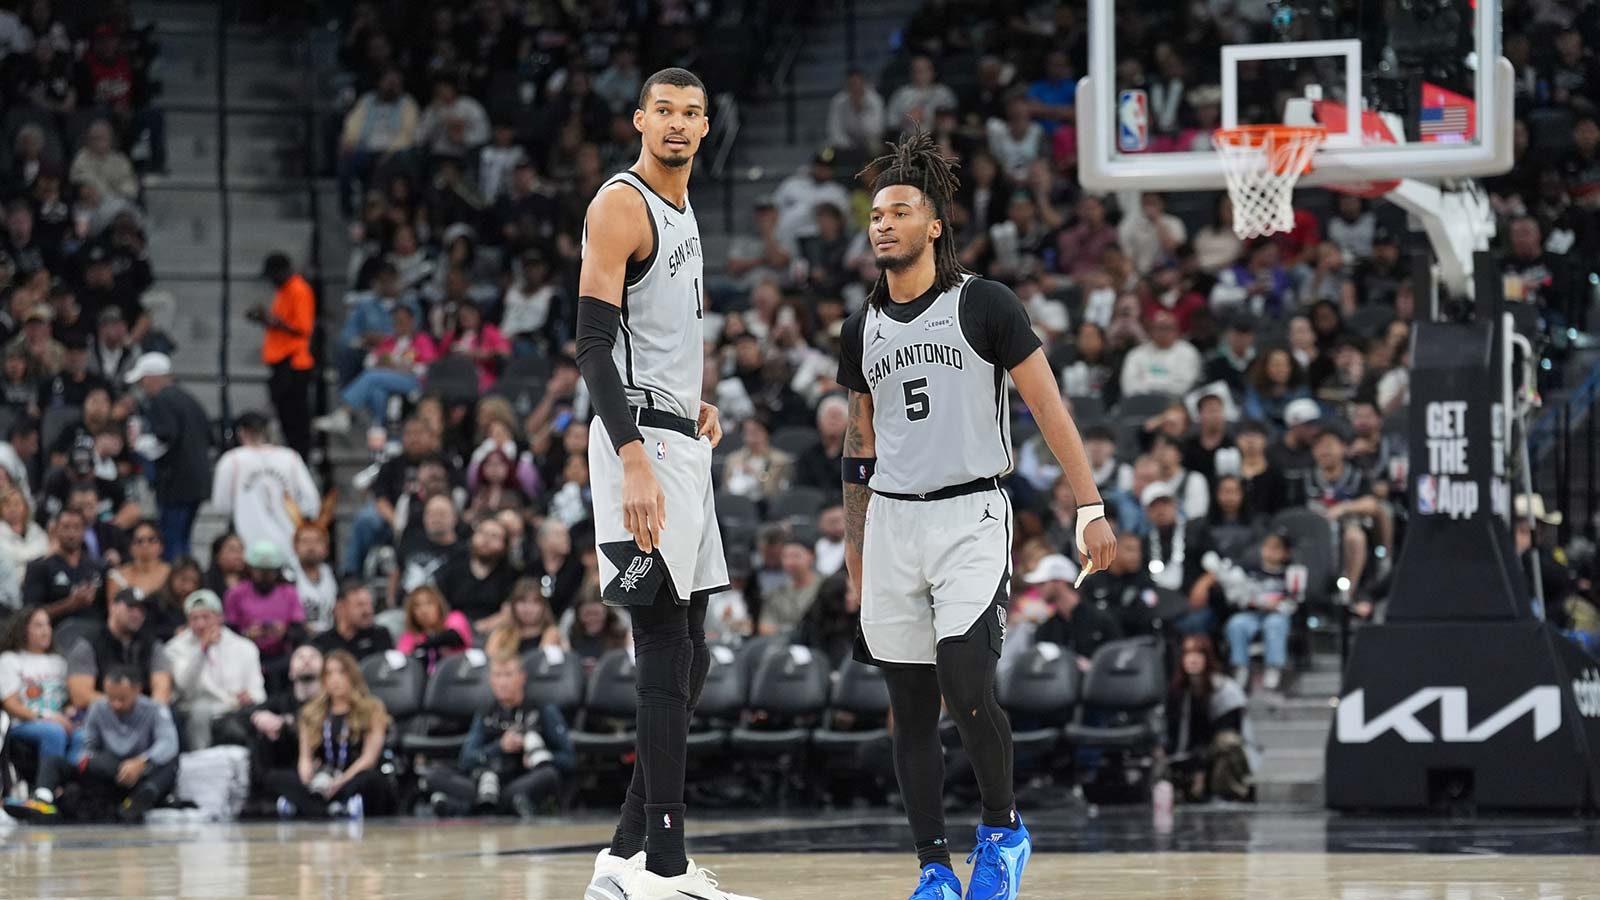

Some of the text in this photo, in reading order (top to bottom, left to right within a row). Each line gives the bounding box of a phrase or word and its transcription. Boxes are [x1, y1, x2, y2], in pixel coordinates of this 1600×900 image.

[669, 243, 686, 278] SAN
[868, 343, 963, 390] SAN ANTONIO
[902, 377, 930, 422] 5
[1426, 401, 1468, 438] GET
[1426, 438, 1469, 475] THE
[1438, 475, 1478, 519] App
[1337, 685, 1562, 743] KIA
